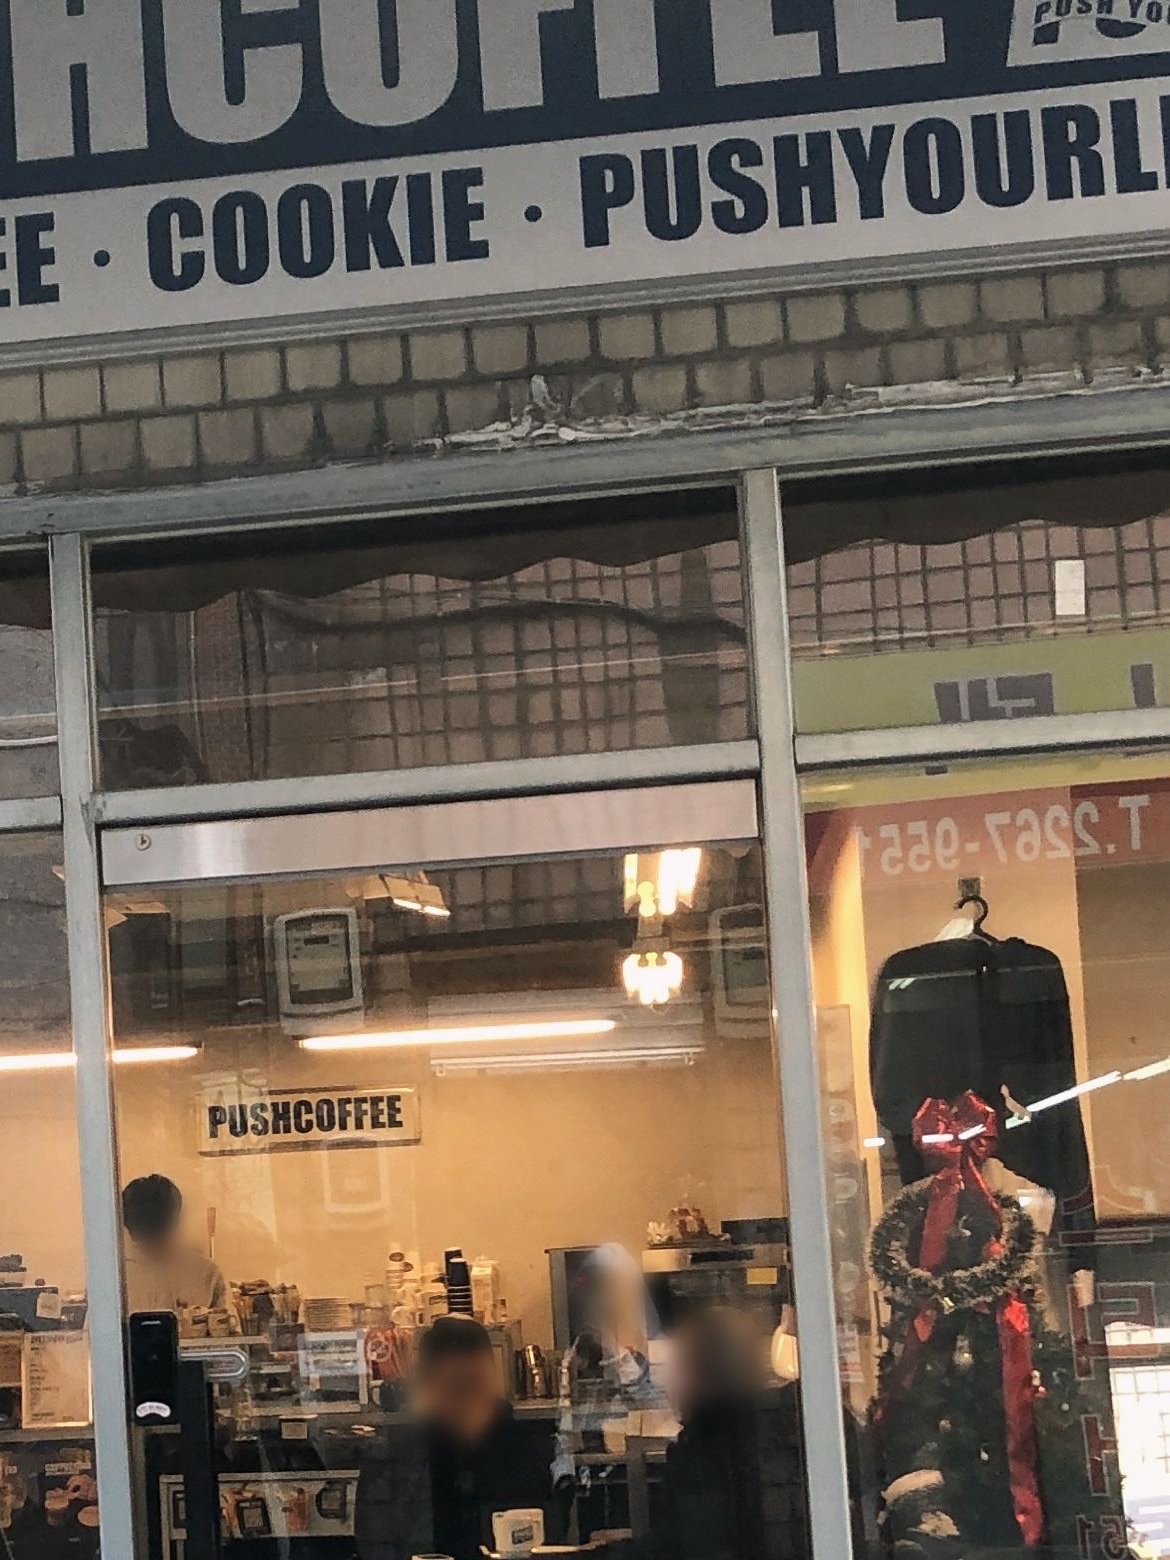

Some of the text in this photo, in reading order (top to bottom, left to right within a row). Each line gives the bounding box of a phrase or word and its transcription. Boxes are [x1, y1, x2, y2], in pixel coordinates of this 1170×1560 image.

[1129, 0, 1170, 25] YO
[146, 167, 490, 292] COOKIE
[207, 1094, 404, 1139] PUSHCOFFEE
